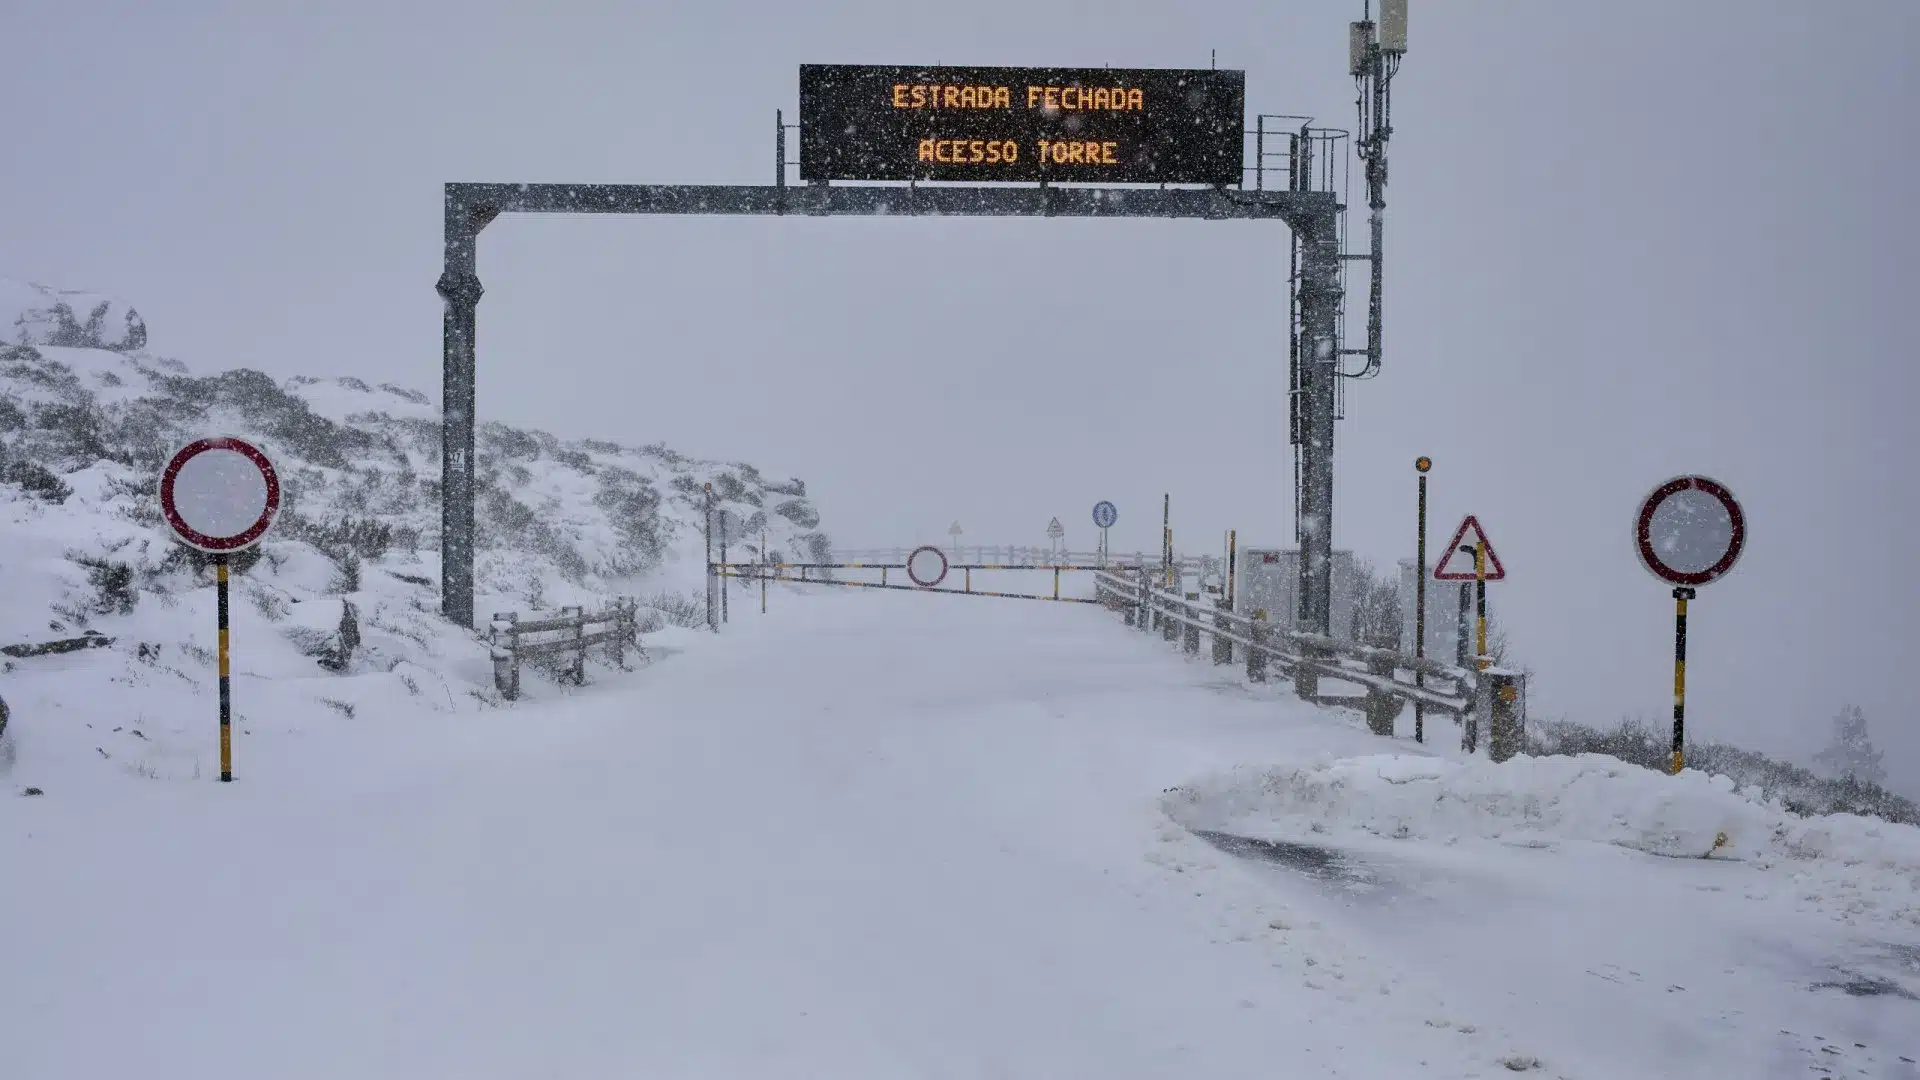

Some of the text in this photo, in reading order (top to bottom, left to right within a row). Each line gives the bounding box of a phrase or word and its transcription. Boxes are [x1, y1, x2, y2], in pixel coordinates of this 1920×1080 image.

[893, 85, 1144, 110] ESTRADA FECHADA
[918, 140, 1117, 164] ACESSO TORRE
